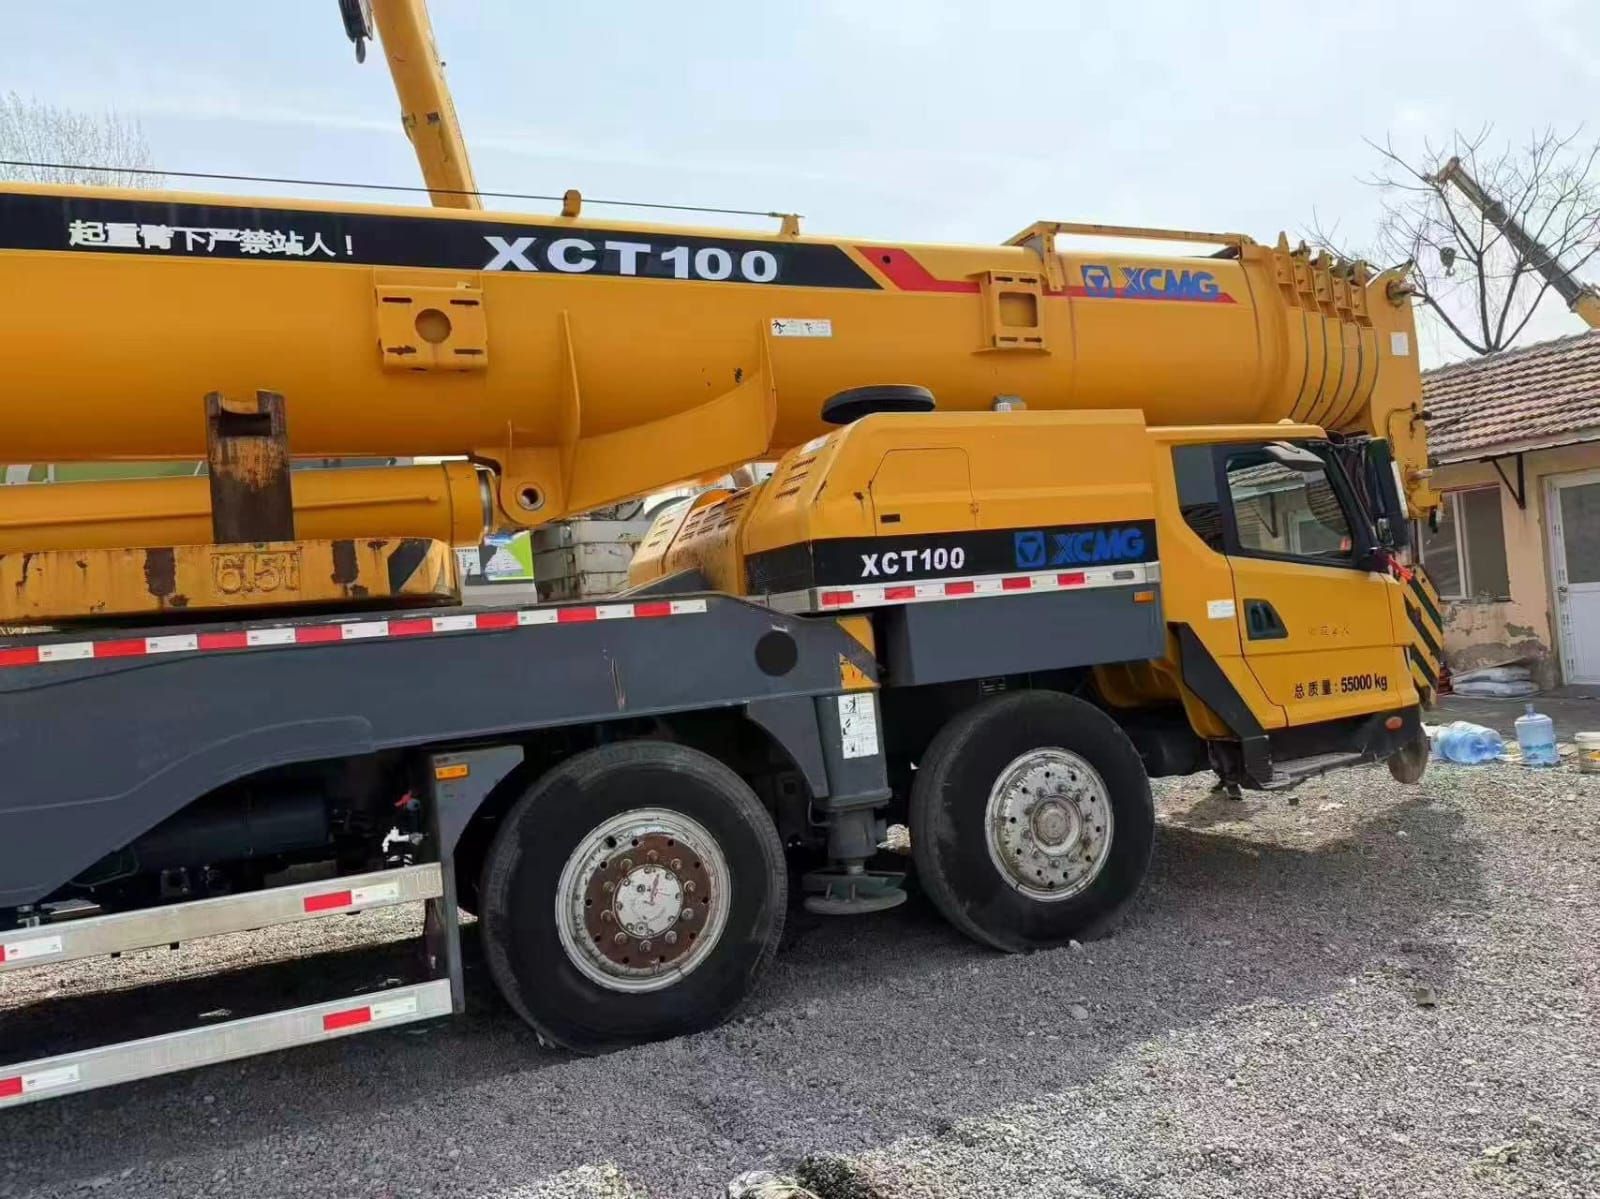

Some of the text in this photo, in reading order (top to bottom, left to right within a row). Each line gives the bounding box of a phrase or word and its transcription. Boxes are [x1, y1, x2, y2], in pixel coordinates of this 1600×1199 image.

[482, 236, 777, 283] XCT100
[1121, 267, 1218, 299] XCMG
[1055, 528, 1144, 563] XCMG
[861, 547, 965, 577] XCT100
[1341, 674, 1372, 693] 55000
[1374, 672, 1388, 691] kg
